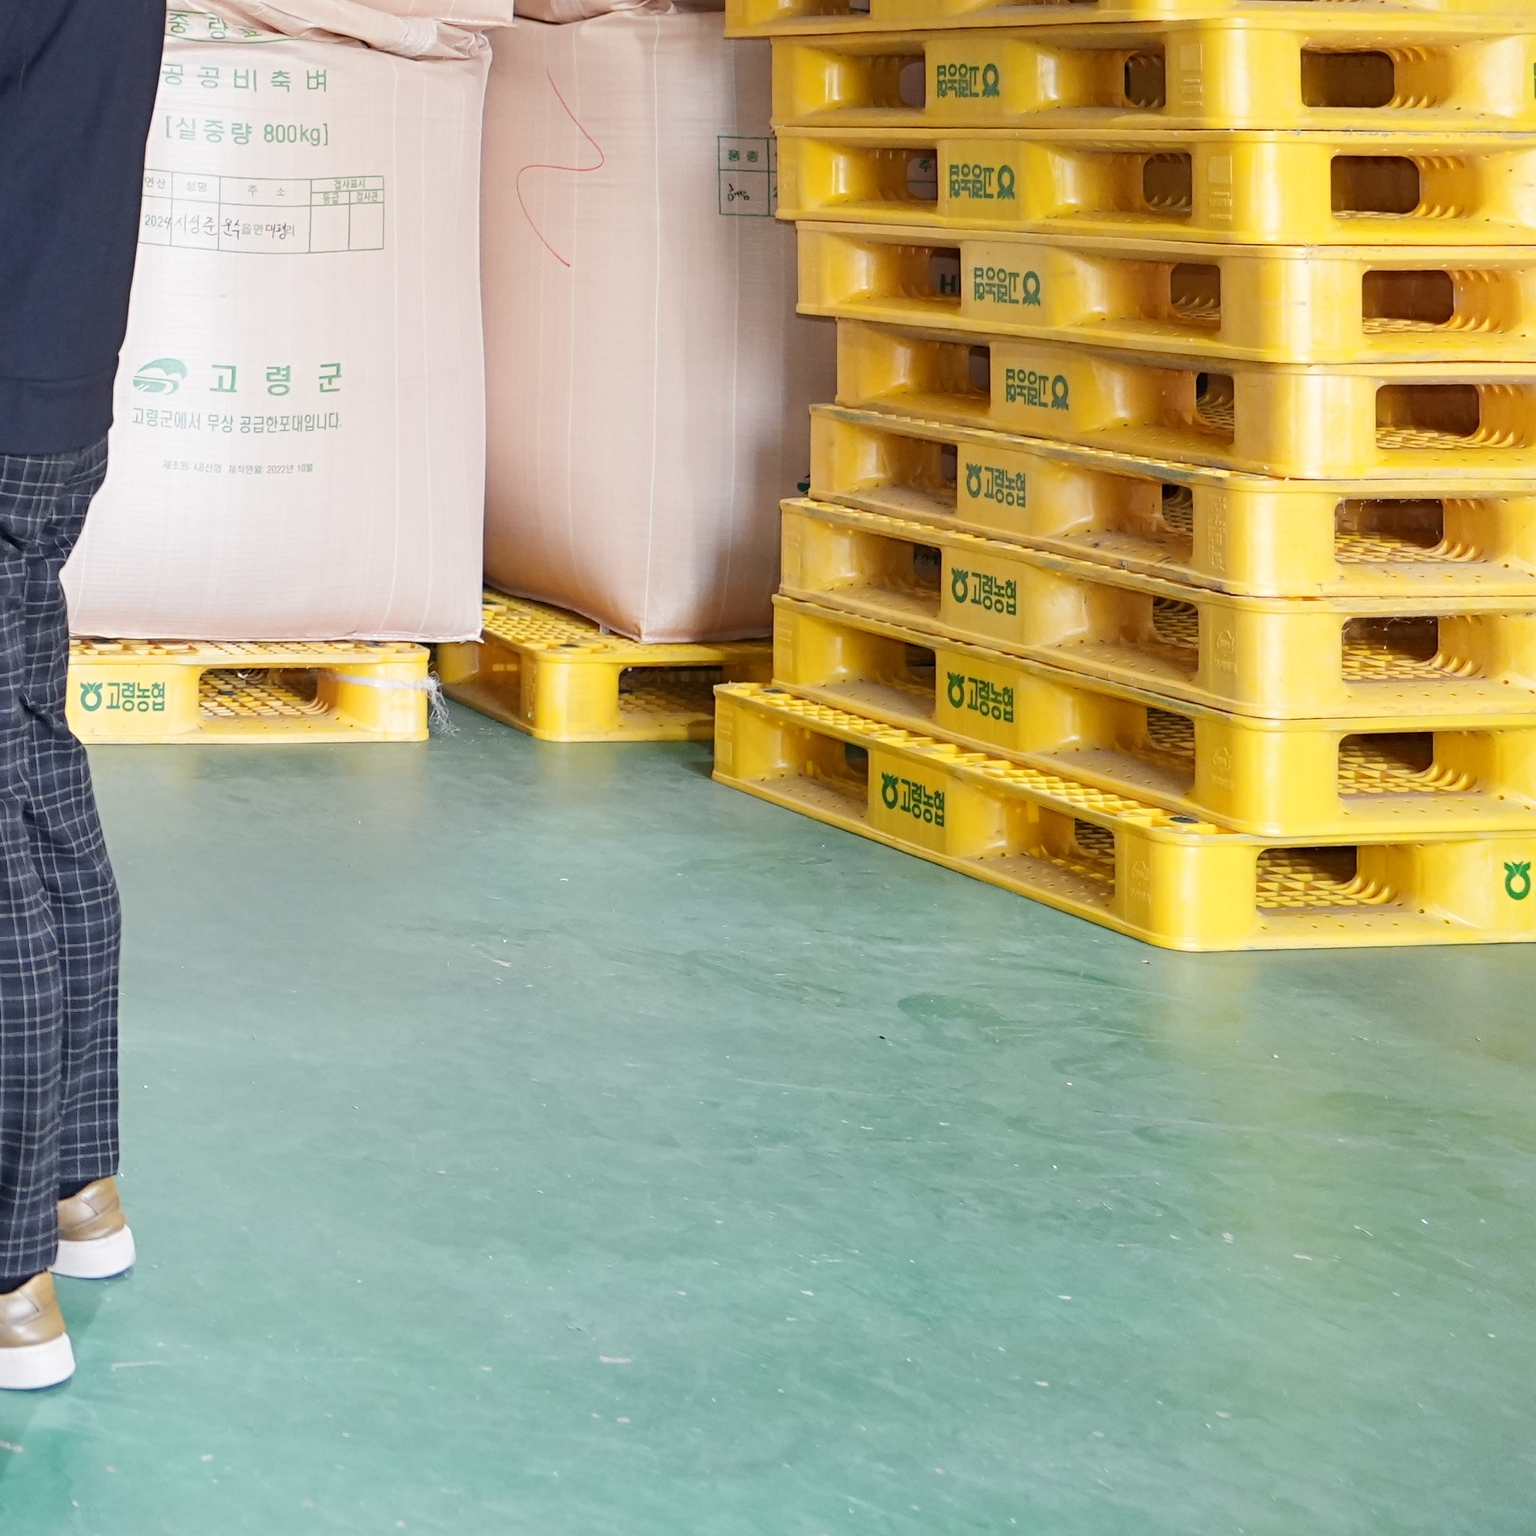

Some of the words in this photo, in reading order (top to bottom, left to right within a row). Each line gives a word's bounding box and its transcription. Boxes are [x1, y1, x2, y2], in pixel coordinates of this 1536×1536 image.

[210, 362, 342, 396] 고령군
[132, 407, 201, 431] 고령군에서
[207, 414, 234, 433] 무상
[971, 571, 1017, 616] 고령농협
[106, 680, 165, 713] 고령농협
[967, 677, 1014, 724] 고령농협
[900, 779, 945, 828] 고령농협
